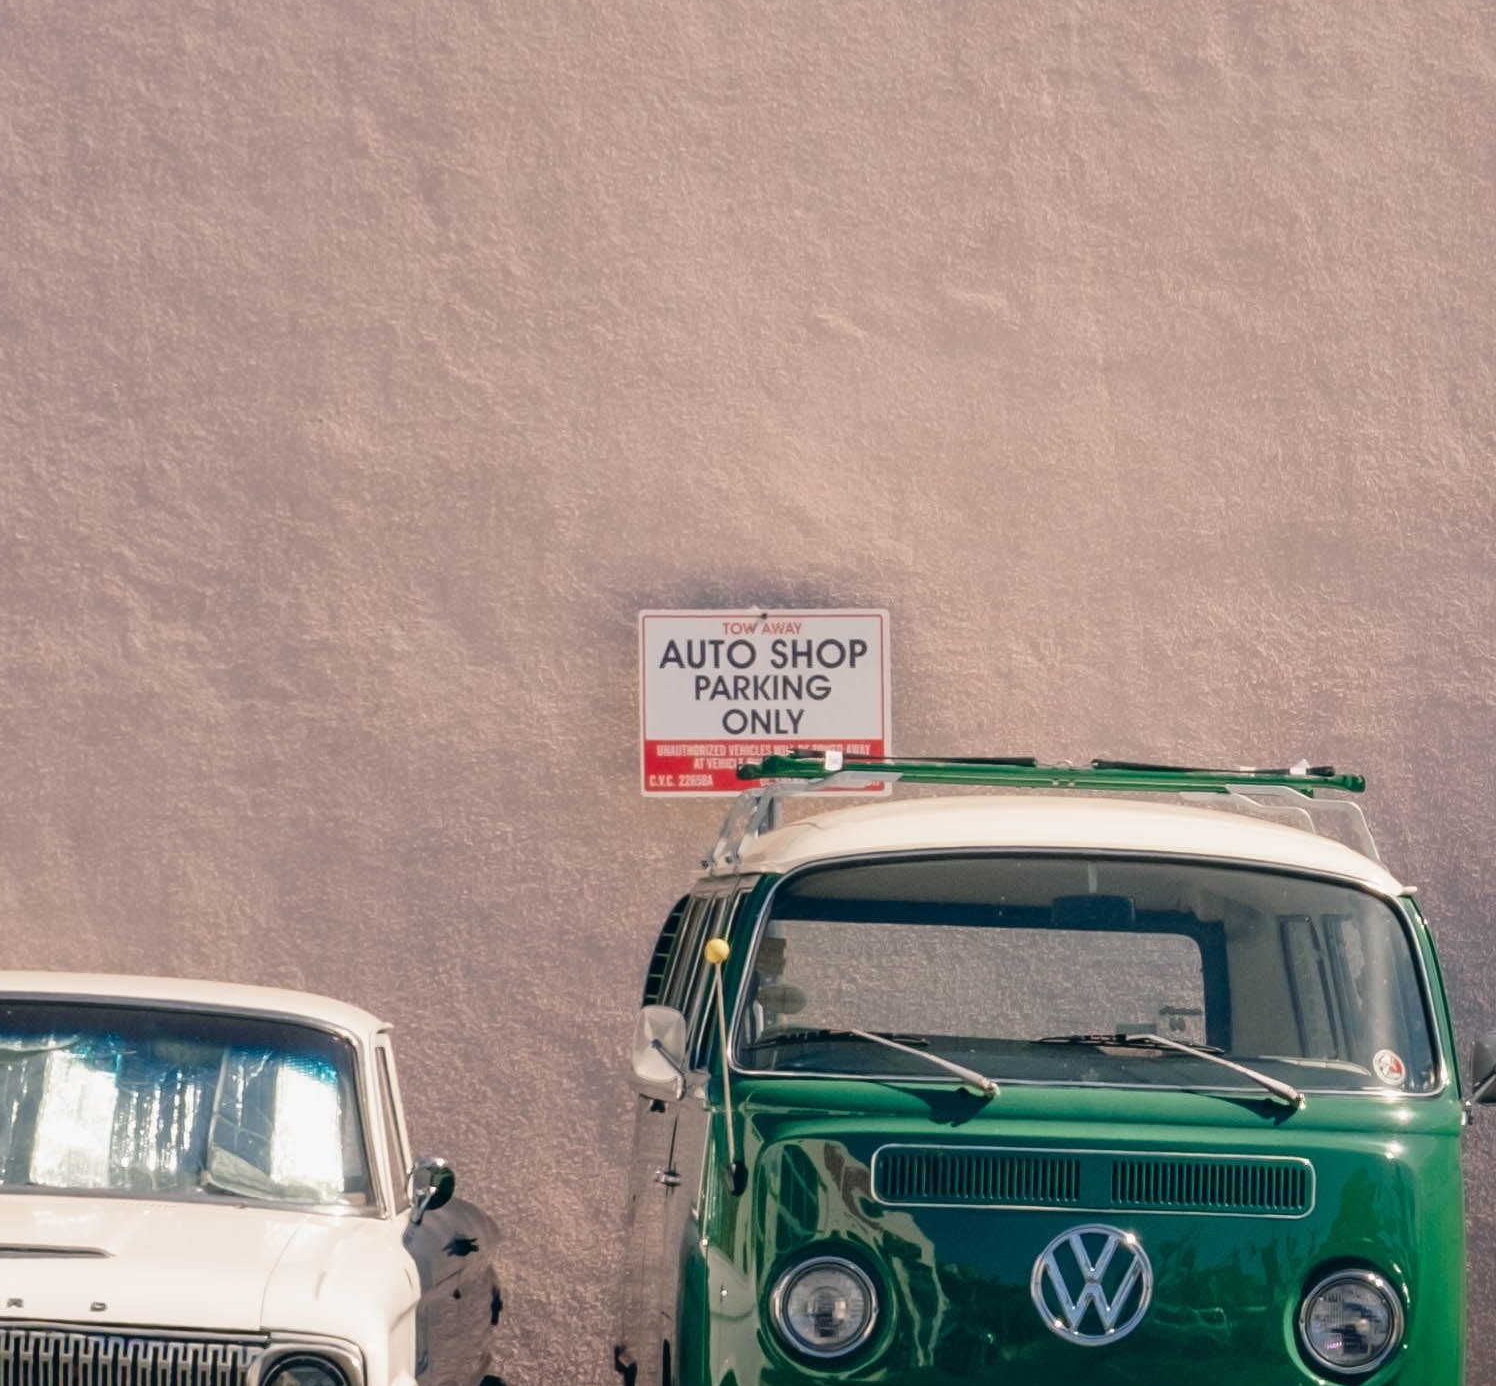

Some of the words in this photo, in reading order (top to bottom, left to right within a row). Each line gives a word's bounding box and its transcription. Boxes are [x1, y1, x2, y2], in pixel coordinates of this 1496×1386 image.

[723, 622, 757, 635] TOW
[761, 622, 803, 635] AWAY
[659, 639, 757, 669] AUTO
[770, 639, 868, 669] SHOP
[694, 675, 832, 701] PARKING
[722, 709, 805, 735] ONLY
